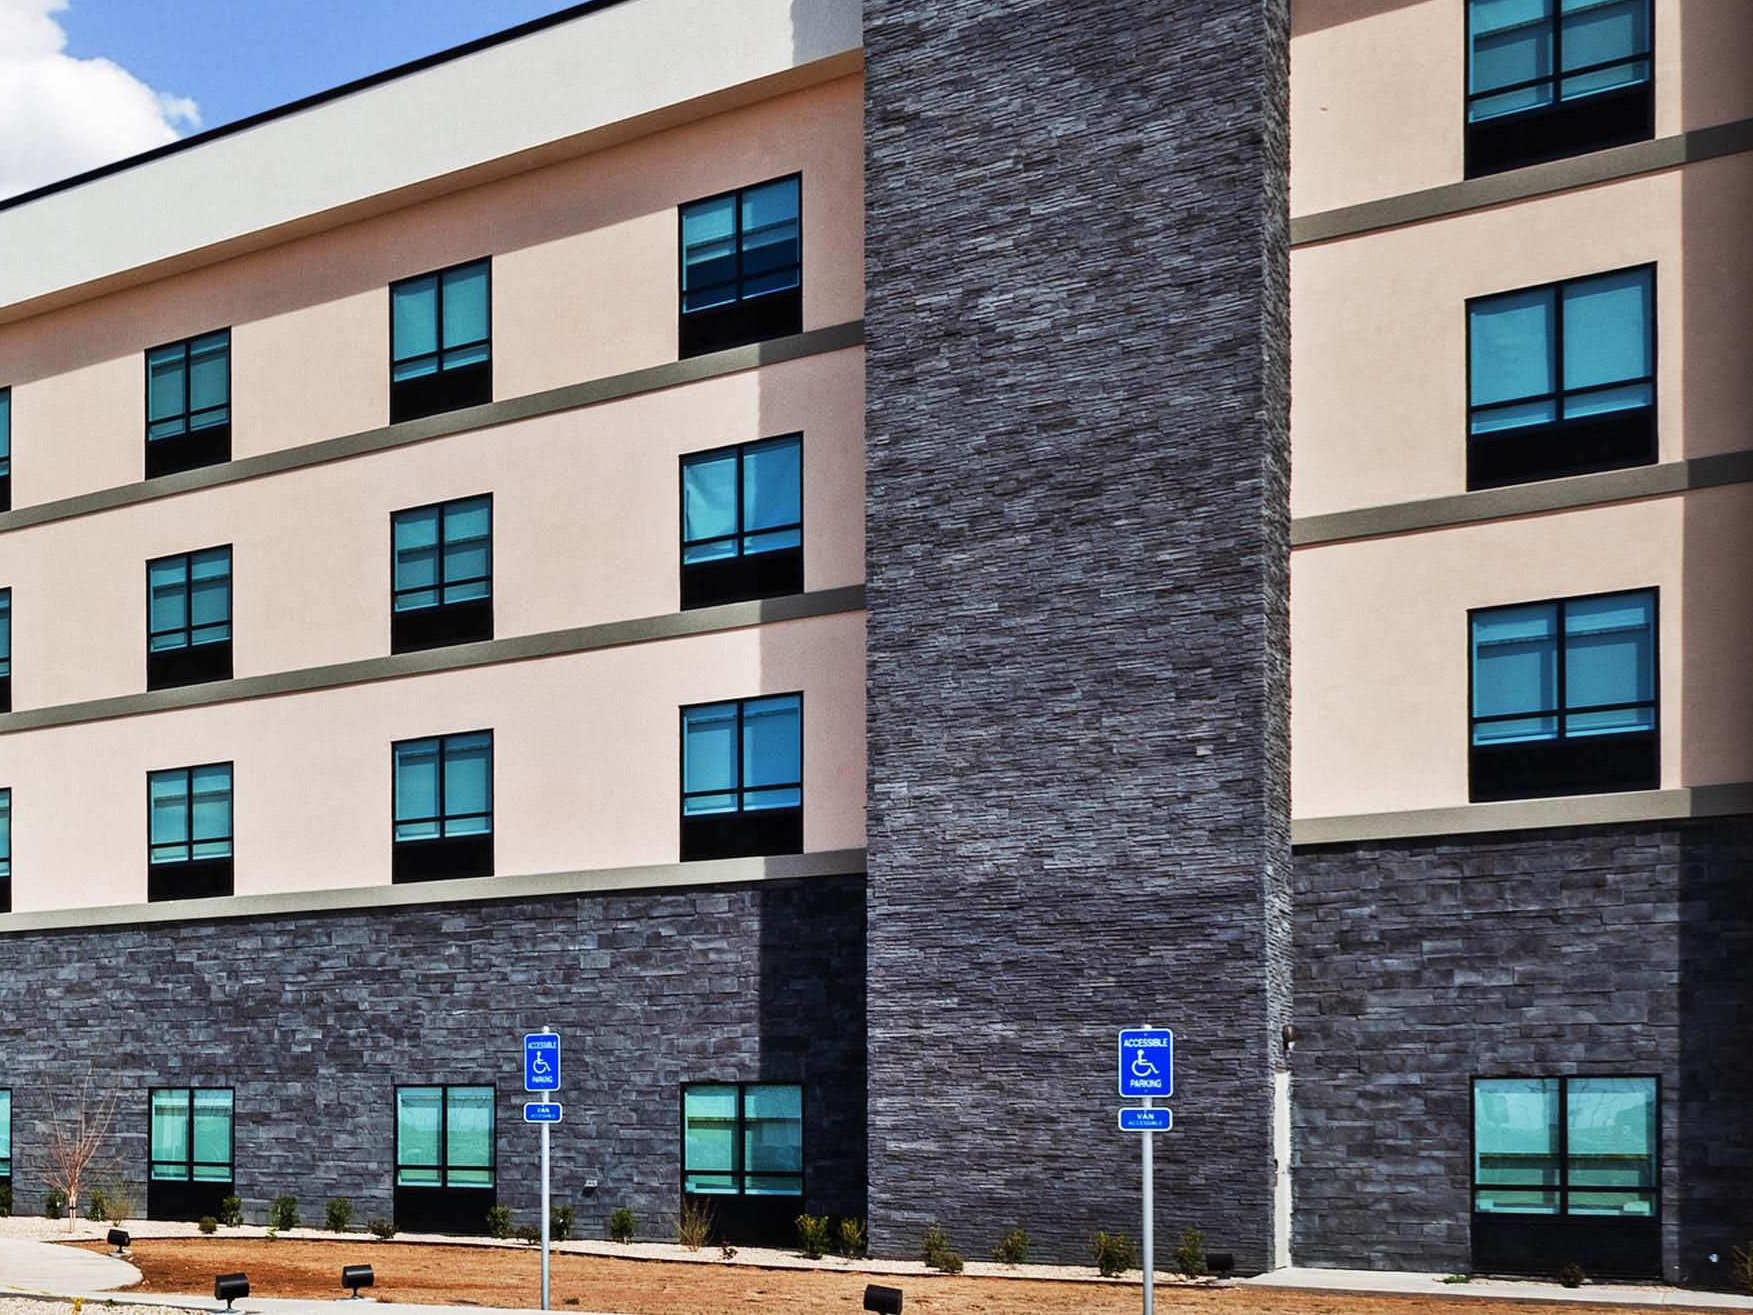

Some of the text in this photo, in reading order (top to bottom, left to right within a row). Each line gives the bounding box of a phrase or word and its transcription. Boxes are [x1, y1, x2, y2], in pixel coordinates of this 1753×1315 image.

[527, 1041, 557, 1049] ACCESSIBLE
[1123, 1038, 1168, 1047] ACCESSIBLE
[532, 1075, 554, 1083] PARKING
[1129, 1079, 1162, 1088] PARKING
